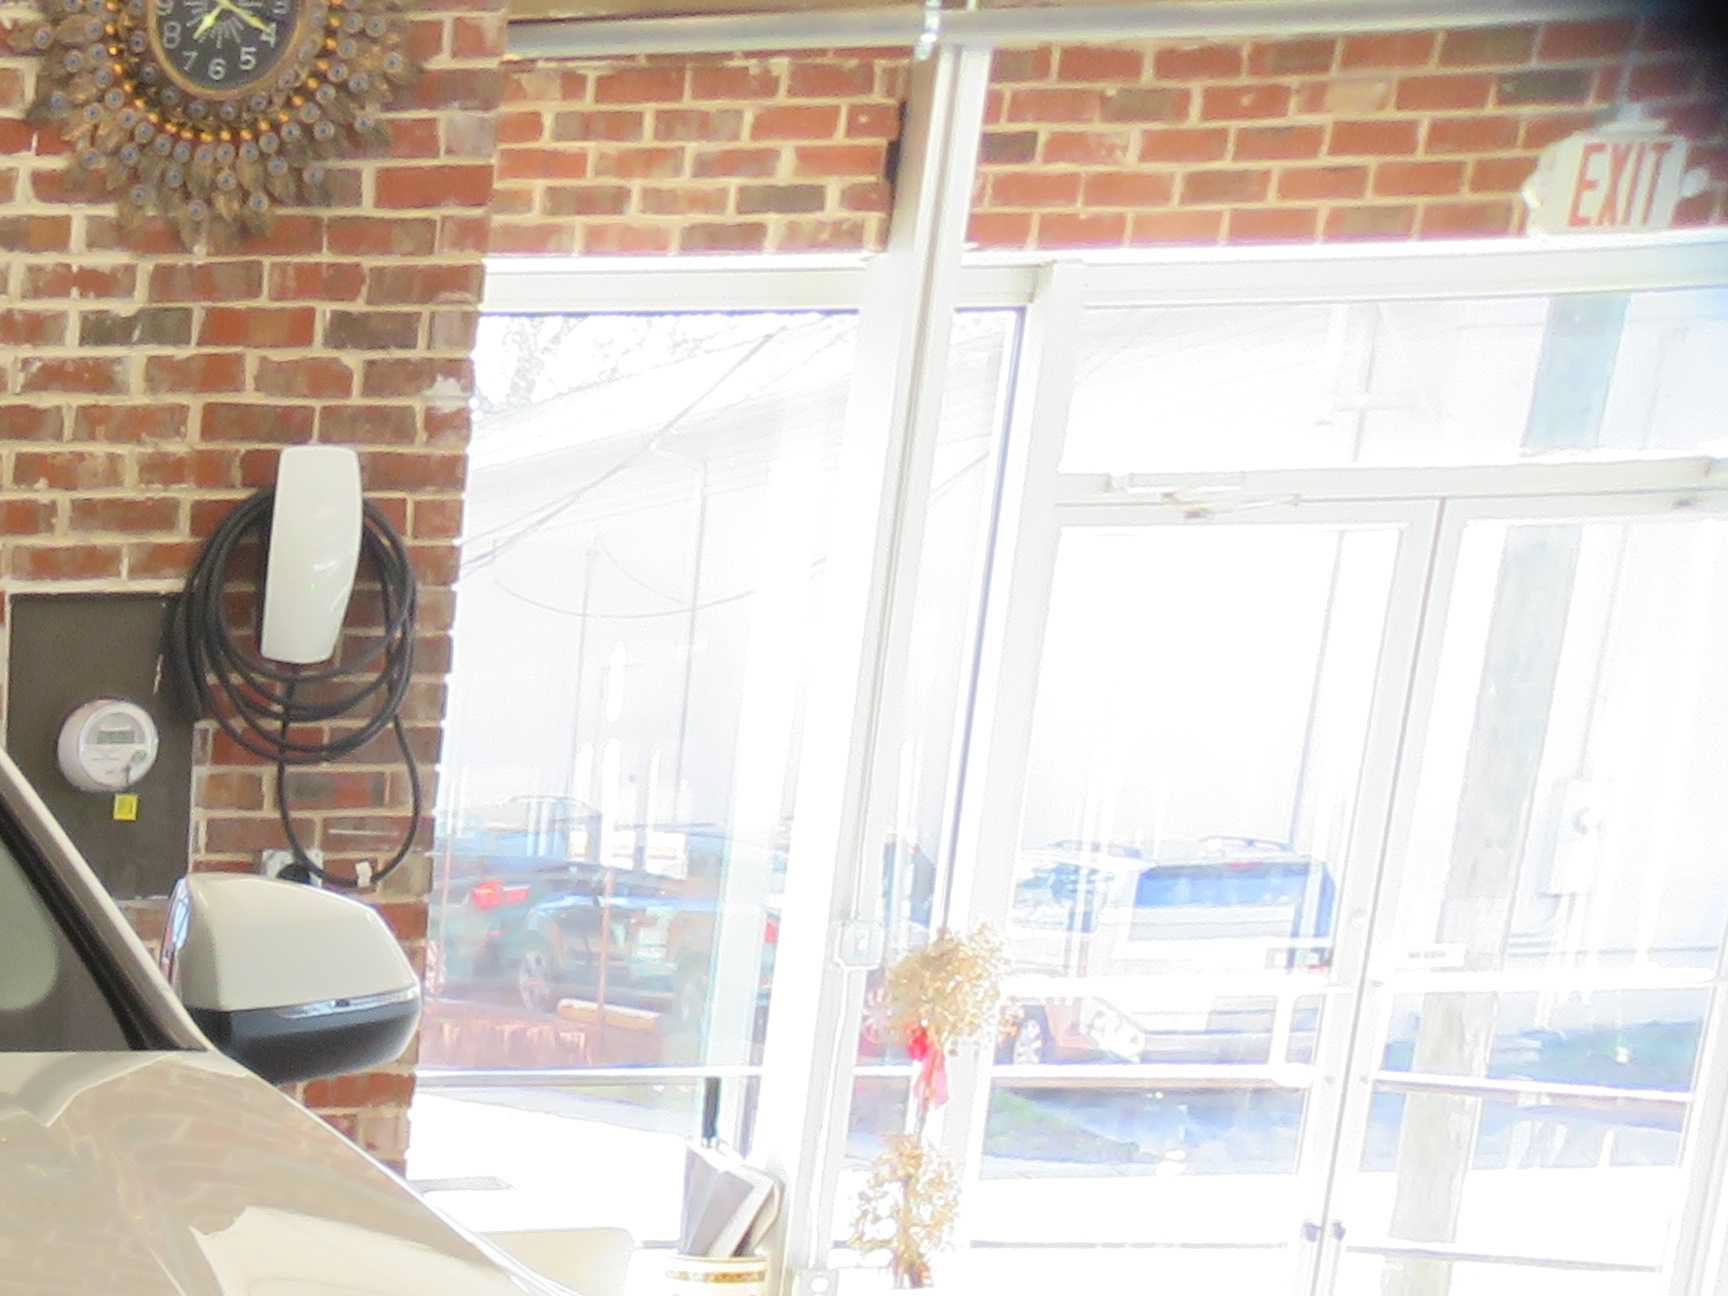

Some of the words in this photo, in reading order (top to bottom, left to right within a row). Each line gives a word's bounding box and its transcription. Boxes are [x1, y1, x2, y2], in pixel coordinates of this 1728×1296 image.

[163, 21, 181, 49] 8
[182, 50, 198, 71] 7
[208, 58, 227, 80] 6
[240, 47, 256, 70] 5
[1567, 142, 1674, 227] EXIT
